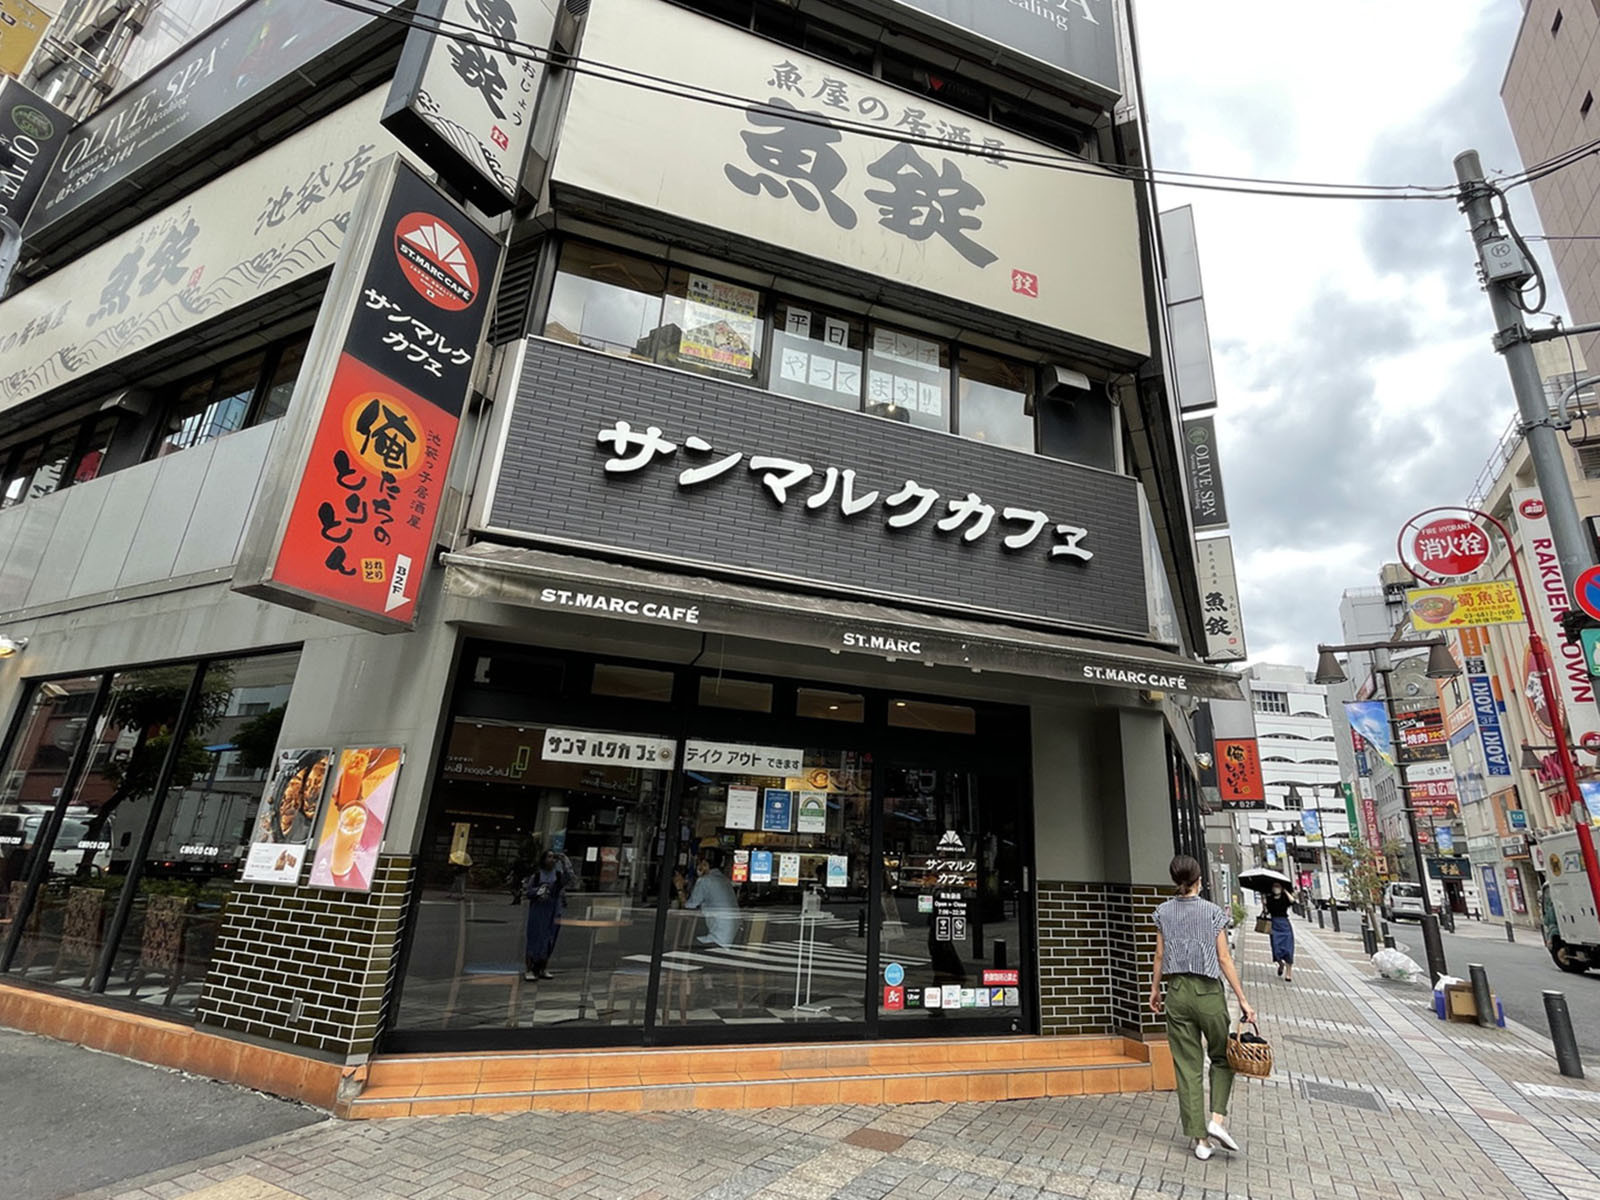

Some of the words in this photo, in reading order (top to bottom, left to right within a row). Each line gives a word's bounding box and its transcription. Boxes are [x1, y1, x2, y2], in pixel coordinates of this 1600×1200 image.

[62, 88, 157, 172] OLIVE
[159, 48, 219, 107] SPA
[766, 60, 1010, 170] 魚屋の居酒屋
[255, 144, 376, 235] 池袋店
[723, 97, 999, 268] 魚錠
[399, 243, 446, 282] ST.MARC
[443, 276, 471, 300] CAFÉ
[364, 288, 472, 365] サンマルク
[788, 314, 846, 345] 平日
[382, 332, 443, 378] カフェ
[356, 398, 417, 547] 俺たちの
[1194, 444, 1212, 488] OLIVE
[596, 419, 1094, 563] サンマルクカフェ
[1200, 489, 1216, 516] SPA
[1421, 526, 1437, 536] FIRE
[1438, 522, 1471, 534] HYDRANT
[1418, 532, 1485, 562] 消火栓
[392, 565, 407, 595] B2F
[1532, 537, 1572, 624] RAKUEN
[540, 588, 639, 614] ST.MARC
[642, 604, 700, 624] CAFÉ
[1205, 591, 1233, 636] 魚錠
[842, 632, 921, 655] ST.MARC
[1082, 664, 1147, 685] ST.MARC
[1148, 673, 1188, 690] CAFÉ
[1472, 681, 1494, 714] AOKI
[548, 737, 656, 761] サンマルクカフェ
[1483, 731, 1505, 765] AOKI
[180, 845, 203, 856] CHOCO
[203, 847, 219, 857] CRO
[925, 859, 976, 872] サンマルク
[937, 873, 965, 885] カフェ
